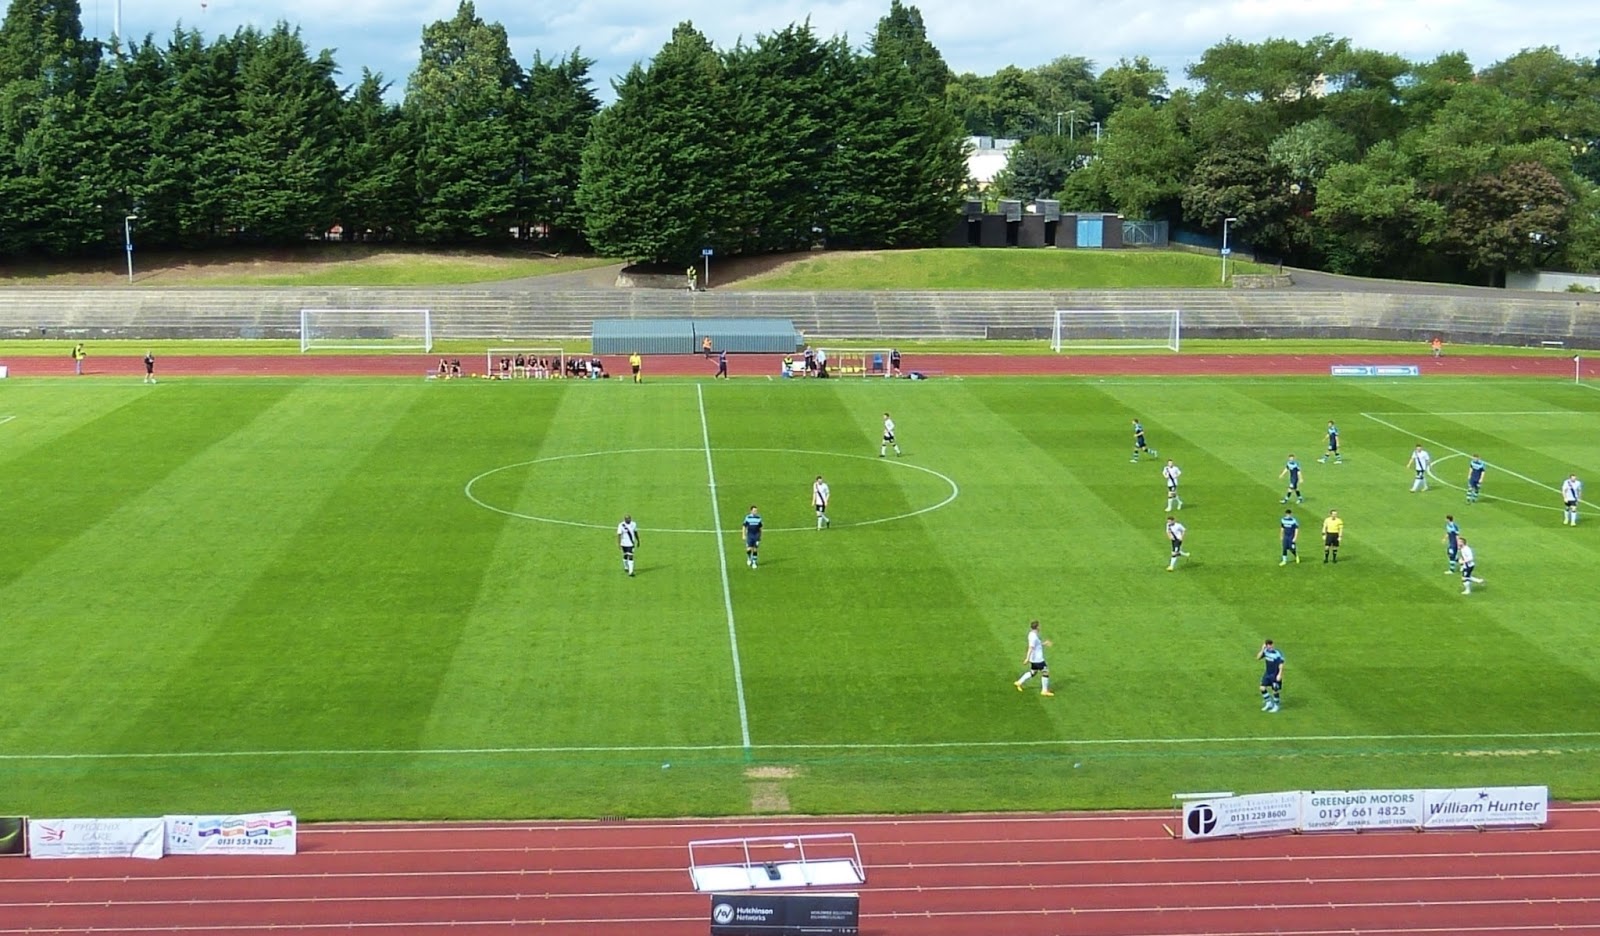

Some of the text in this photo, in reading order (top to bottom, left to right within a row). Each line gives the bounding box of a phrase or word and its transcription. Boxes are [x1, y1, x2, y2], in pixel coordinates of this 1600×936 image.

[1311, 794, 1415, 806] GREENEND MOTORS
[1320, 806, 1406, 819] 0131 661 4825
[1430, 802, 1483, 814] William
[1488, 800, 1540, 812] Hunter
[1231, 810, 1287, 822] 0131 229 8600
[736, 907, 774, 915] Hutchinson
